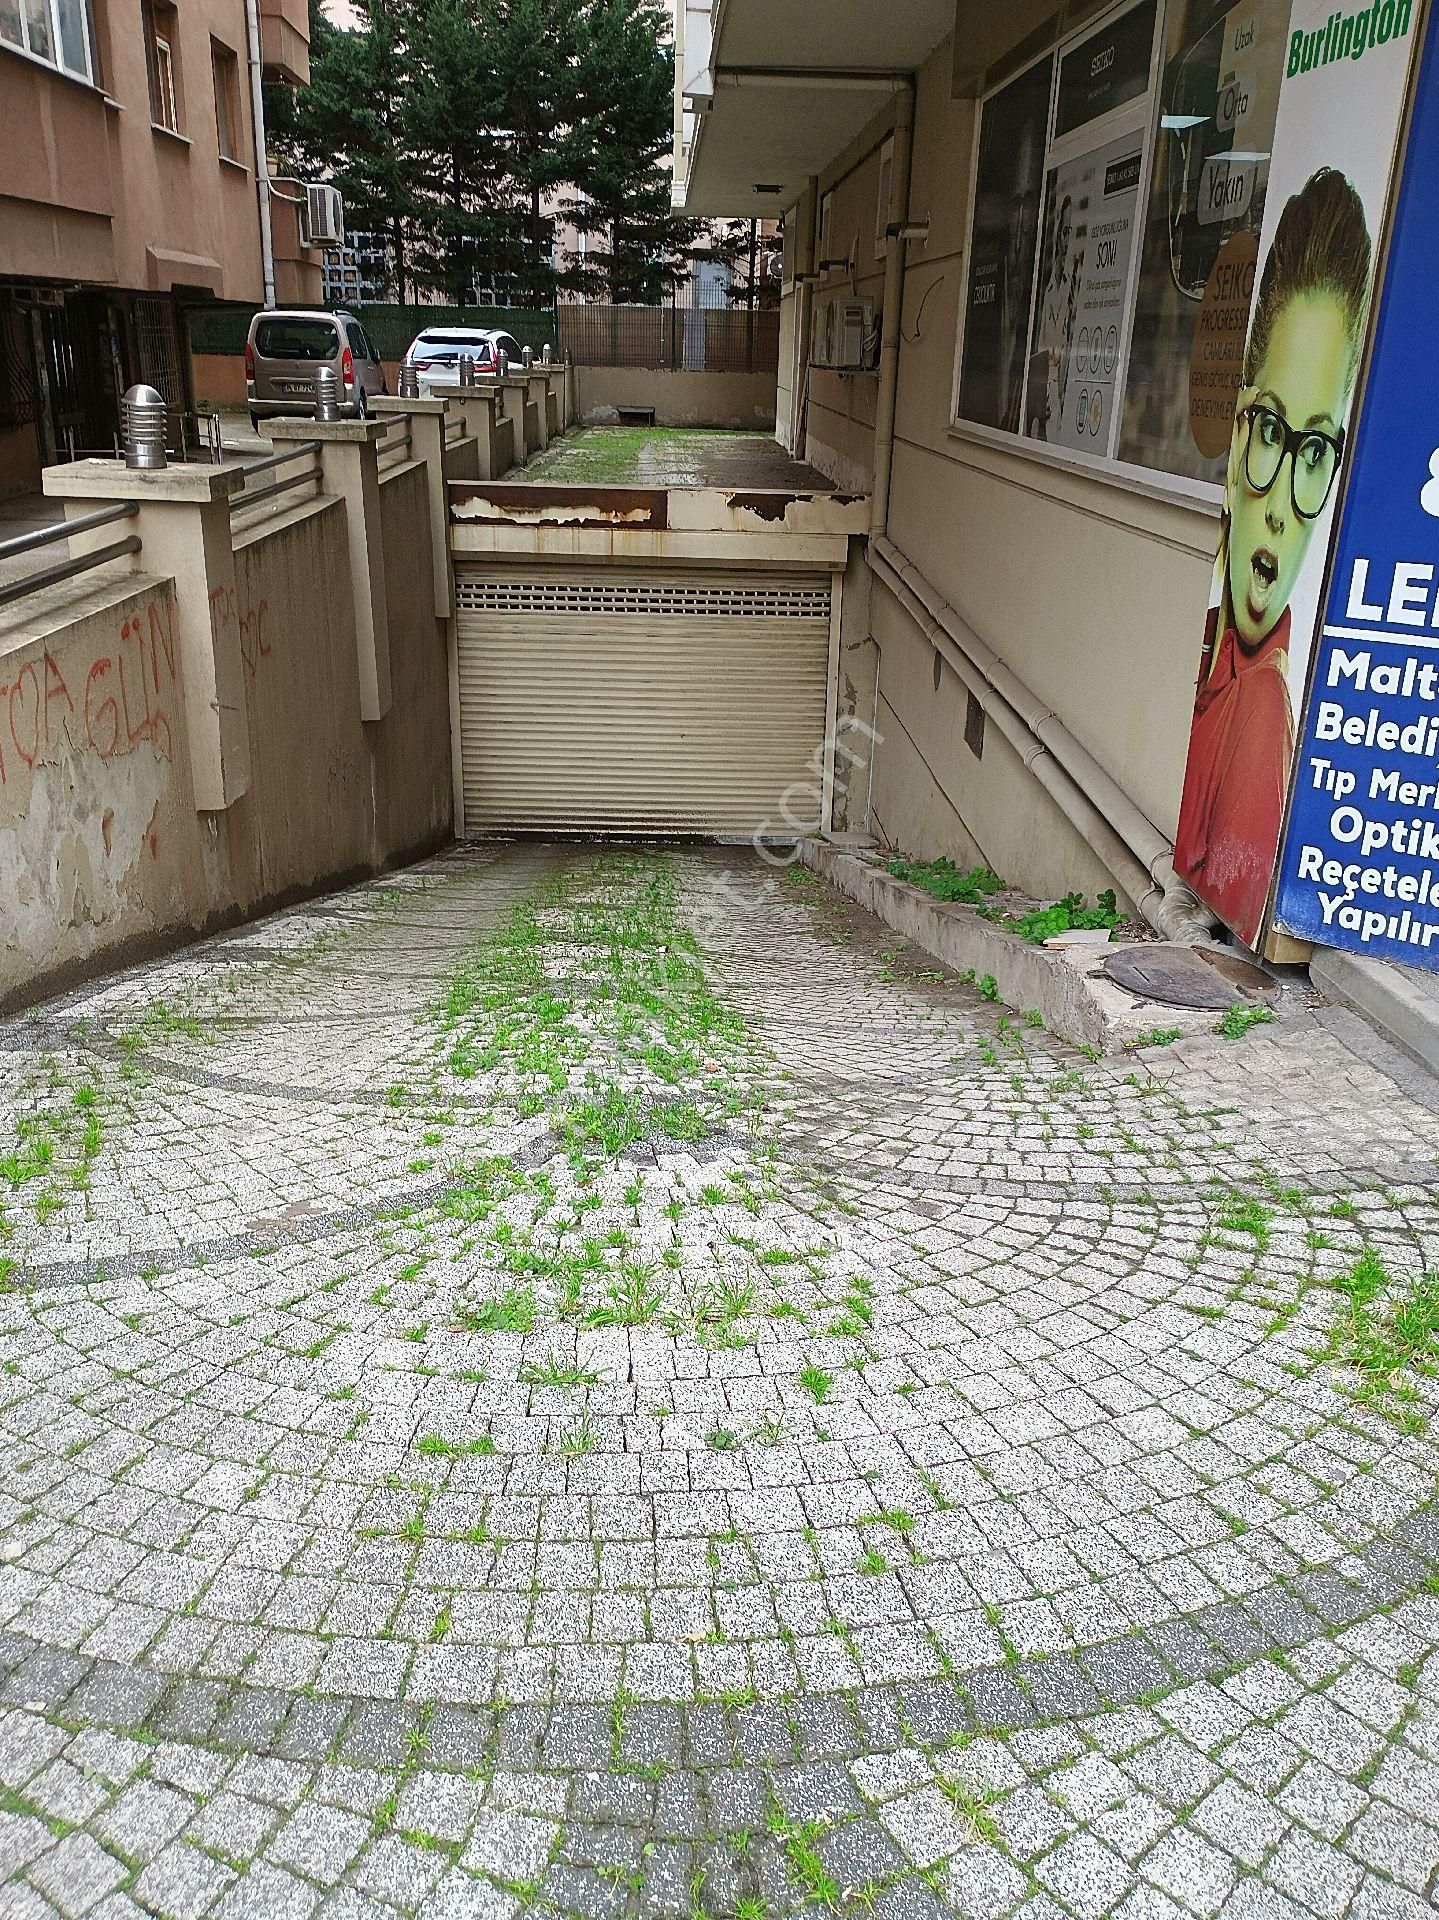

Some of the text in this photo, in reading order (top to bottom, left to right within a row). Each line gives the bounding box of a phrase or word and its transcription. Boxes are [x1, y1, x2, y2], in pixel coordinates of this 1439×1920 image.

[1090, 46, 1115, 77] SEIKO
[1234, 20, 1255, 51] Uzak
[1287, 0, 1412, 79] Burlington
[1223, 88, 1249, 121] Orta
[1208, 161, 1244, 209] Yakın
[1095, 239, 1118, 270] SON!
[1345, 558, 1439, 629] LE
[1325, 648, 1439, 702] Malt
[1314, 701, 1439, 769] Beledi
[1309, 757, 1439, 810] Tıp Mer
[1330, 806, 1439, 860] Optik
[1317, 891, 1439, 947] Yapılır
